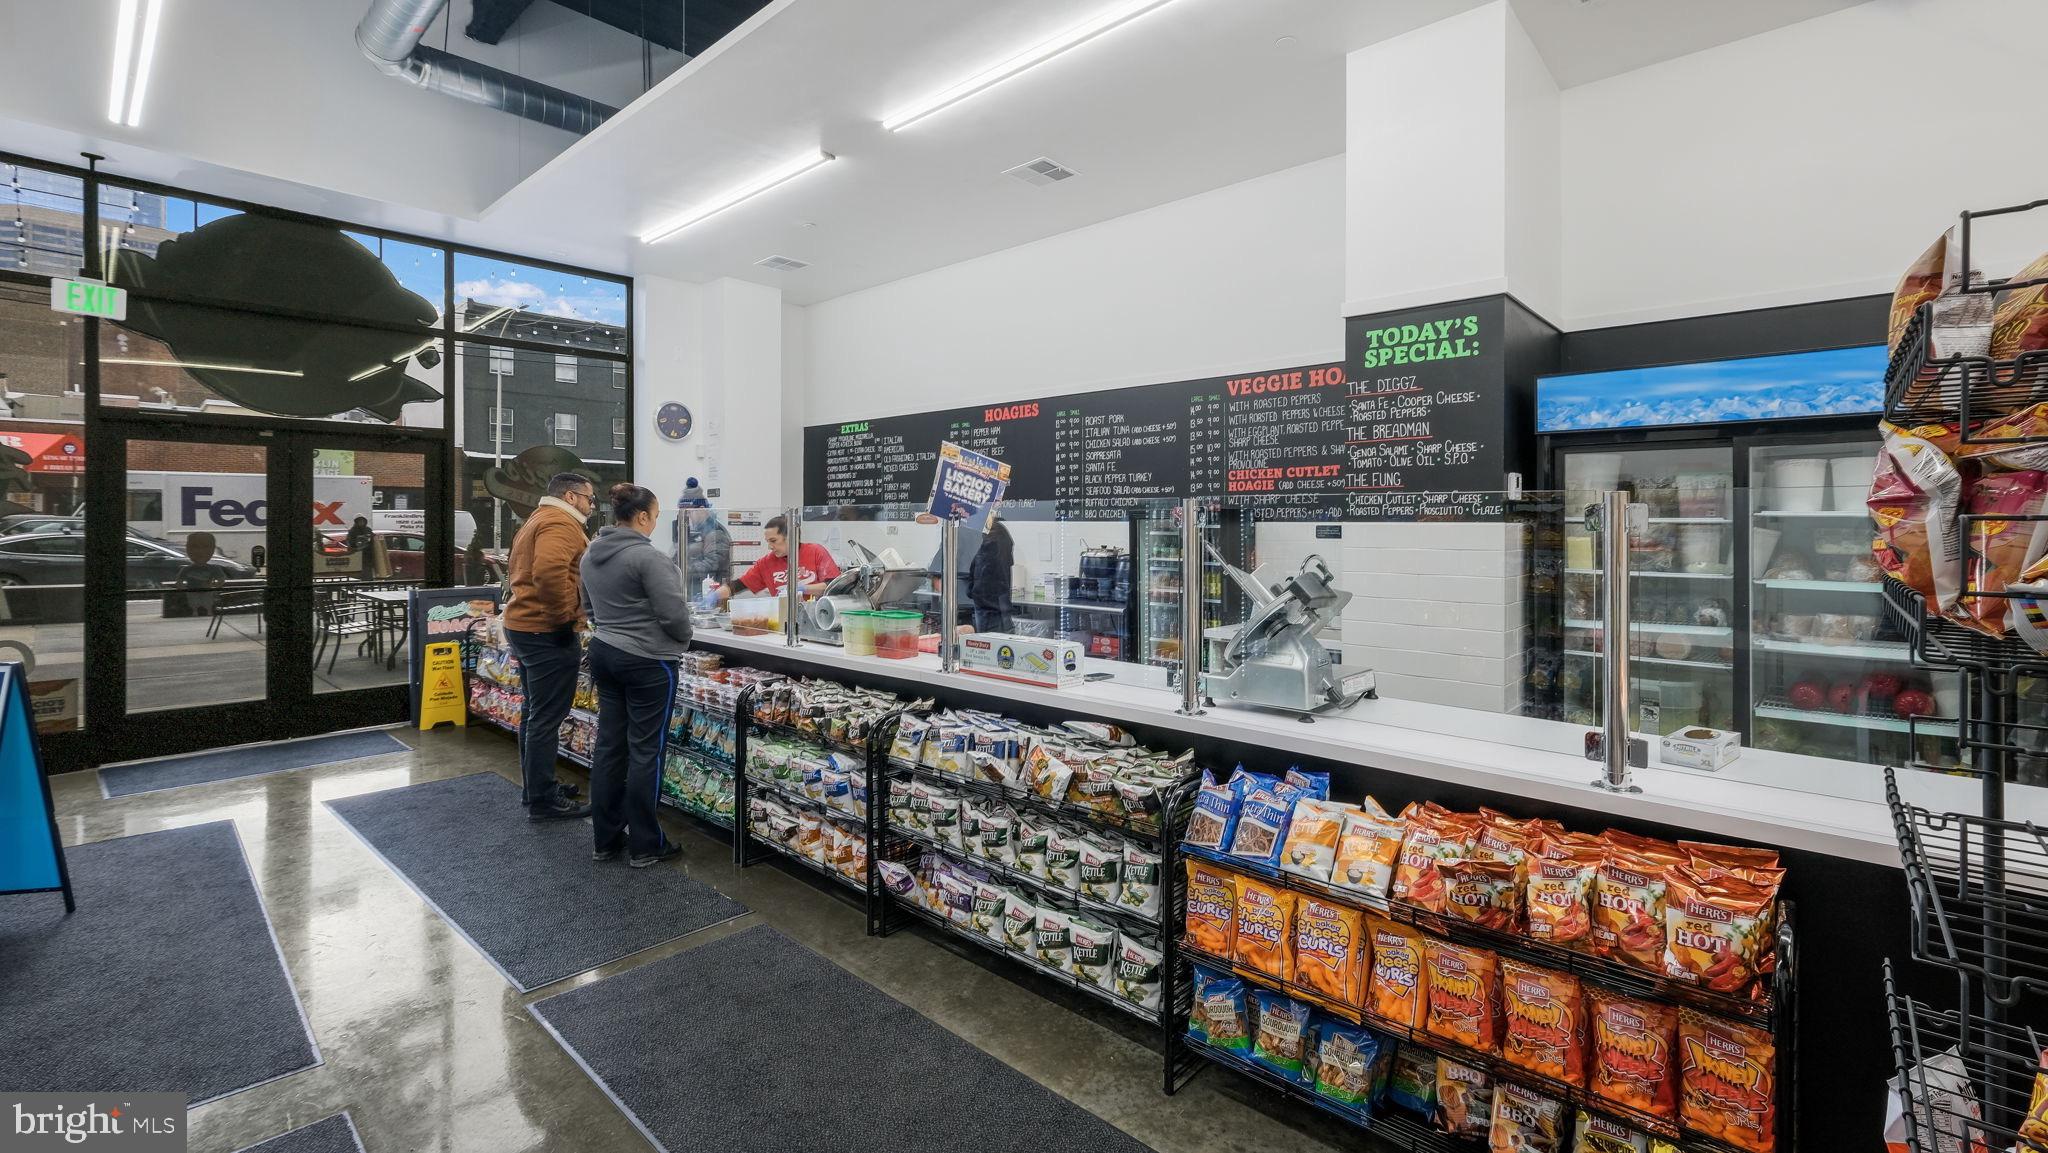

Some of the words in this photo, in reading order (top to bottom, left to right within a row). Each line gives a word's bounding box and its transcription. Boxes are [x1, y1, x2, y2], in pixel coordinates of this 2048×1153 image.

[66, 282, 118, 316] EXIT
[1366, 316, 1479, 348] TODAY'S
[1364, 338, 1480, 368] SPECIAL:
[1227, 372, 1302, 396] VEGGIE
[1346, 380, 1371, 394] THE
[1377, 375, 1418, 392] DIGGZ
[1229, 402, 1250, 413] WITH
[1253, 397, 1288, 410] ROASTED
[1291, 393, 1322, 405] PEPPERS
[1351, 399, 1376, 412] SANTA
[1397, 394, 1433, 409] COOPER
[1436, 391, 1475, 405] CHEESE
[985, 402, 1040, 423] HOAGIES
[1229, 415, 1248, 426] WITH
[1249, 411, 1277, 424] ROASTED
[1282, 408, 1311, 420] PEPPERS
[1319, 405, 1345, 417] CHEESE
[1352, 409, 1386, 422] ROASTED
[1390, 407, 1427, 420] PEPPERS
[841, 422, 869, 434] EXTRAS
[1085, 415, 1105, 427] ROAST
[1109, 414, 1125, 425] PORK
[1085, 427, 1110, 438] ITALIAN
[1113, 426, 1130, 436] TUNA
[1229, 428, 1248, 439] WITH
[1287, 422, 1318, 435] ROASTED
[1346, 426, 1368, 441] THE
[1373, 421, 1430, 439] BREADMAN
[1085, 439, 1111, 449] CHICKEN
[1252, 435, 1279, 446] CHEESE
[1229, 451, 1249, 462] WITH
[1250, 448, 1281, 460] ROASTED
[1283, 446, 1318, 457] PEPPERS
[1349, 446, 1376, 459] GENOA
[1378, 443, 1409, 457] SALAMI
[1416, 441, 1442, 455] SHARP
[1444, 439, 1477, 453] CHEESE
[1085, 463, 1104, 474] SANTA
[1107, 461, 1116, 472] FE
[1351, 457, 1383, 469] TOMATO
[1389, 455, 1413, 468] OLIVE
[1416, 454, 1435, 466] OIL
[1104, 473, 1126, 484] PEPPER
[1128, 472, 1152, 483] TURKEY
[1228, 468, 1282, 480] CHICKEN
[1286, 464, 1341, 478] CUTLET
[1345, 473, 1369, 487] THE
[1372, 472, 1402, 486] FUNG
[945, 467, 993, 494] LISCIO'S
[1228, 480, 1275, 492] HOAGIE
[1297, 479, 1325, 489] CHEESE
[943, 480, 990, 505] BAKERY
[1085, 486, 1111, 496] SEAFOOD
[1285, 493, 1319, 504] CHEESE
[1348, 491, 1383, 505] CHICKEN
[1385, 493, 1415, 505] CUTLET
[1422, 492, 1449, 505] SHARP
[1451, 490, 1482, 504] CHEESE
[1085, 510, 1097, 519] BBQ
[1098, 509, 1127, 519] CHICKEN
[1276, 507, 1308, 518] PEPPERS
[1350, 503, 1380, 516] ROASTED
[1382, 503, 1414, 516] PEPPERS
[1419, 503, 1464, 516] PROSCIUTTO
[1472, 502, 1501, 515] GLAZE
[1209, 796, 1230, 814] Thin
[1353, 827, 1378, 841] HERR'S
[1483, 835, 1508, 852] HERR'S
[1479, 850, 1495, 860] red
[1081, 865, 1105, 879] KETTLE
[1124, 865, 1148, 879] KETTLE
[1197, 872, 1220, 887] HERR'S
[1543, 865, 1575, 879] HERR'S
[1611, 868, 1644, 887] HERR'S
[1204, 886, 1226, 898] baked
[1456, 884, 1478, 893] red
[1543, 881, 1566, 891] red
[1607, 883, 1631, 896] red
[1540, 893, 1575, 907] HOT
[1599, 892, 1643, 914] HOT
[1187, 900, 1231, 920] CURLS
[1308, 902, 1338, 919] HERR'S
[1690, 903, 1729, 921] HERR'S
[1315, 921, 1341, 932] baked
[1686, 922, 1713, 934] red
[1038, 931, 1063, 945] KETTLE
[1297, 921, 1349, 948] Cheese
[1376, 931, 1404, 948] HERR'S
[1677, 928, 1727, 954] HOT
[1073, 946, 1097, 960] KETTLE
[1298, 935, 1346, 959] CURLS
[1386, 948, 1410, 960] baked
[1120, 963, 1148, 978] KETTLE
[1441, 957, 1464, 971] HERR'S
[1521, 983, 1546, 998] HERR'S
[1271, 1005, 1293, 1020] HERR'S
[1612, 1012, 1640, 1027] HERR'S
[1261, 1014, 1299, 1036] SOURDOUGH
[1710, 1037, 1741, 1054] HERR'S
[1447, 1067, 1481, 1085] BBQ
[1499, 1105, 1538, 1129] BBQ
[1593, 1116, 1627, 1138] HERR'S
